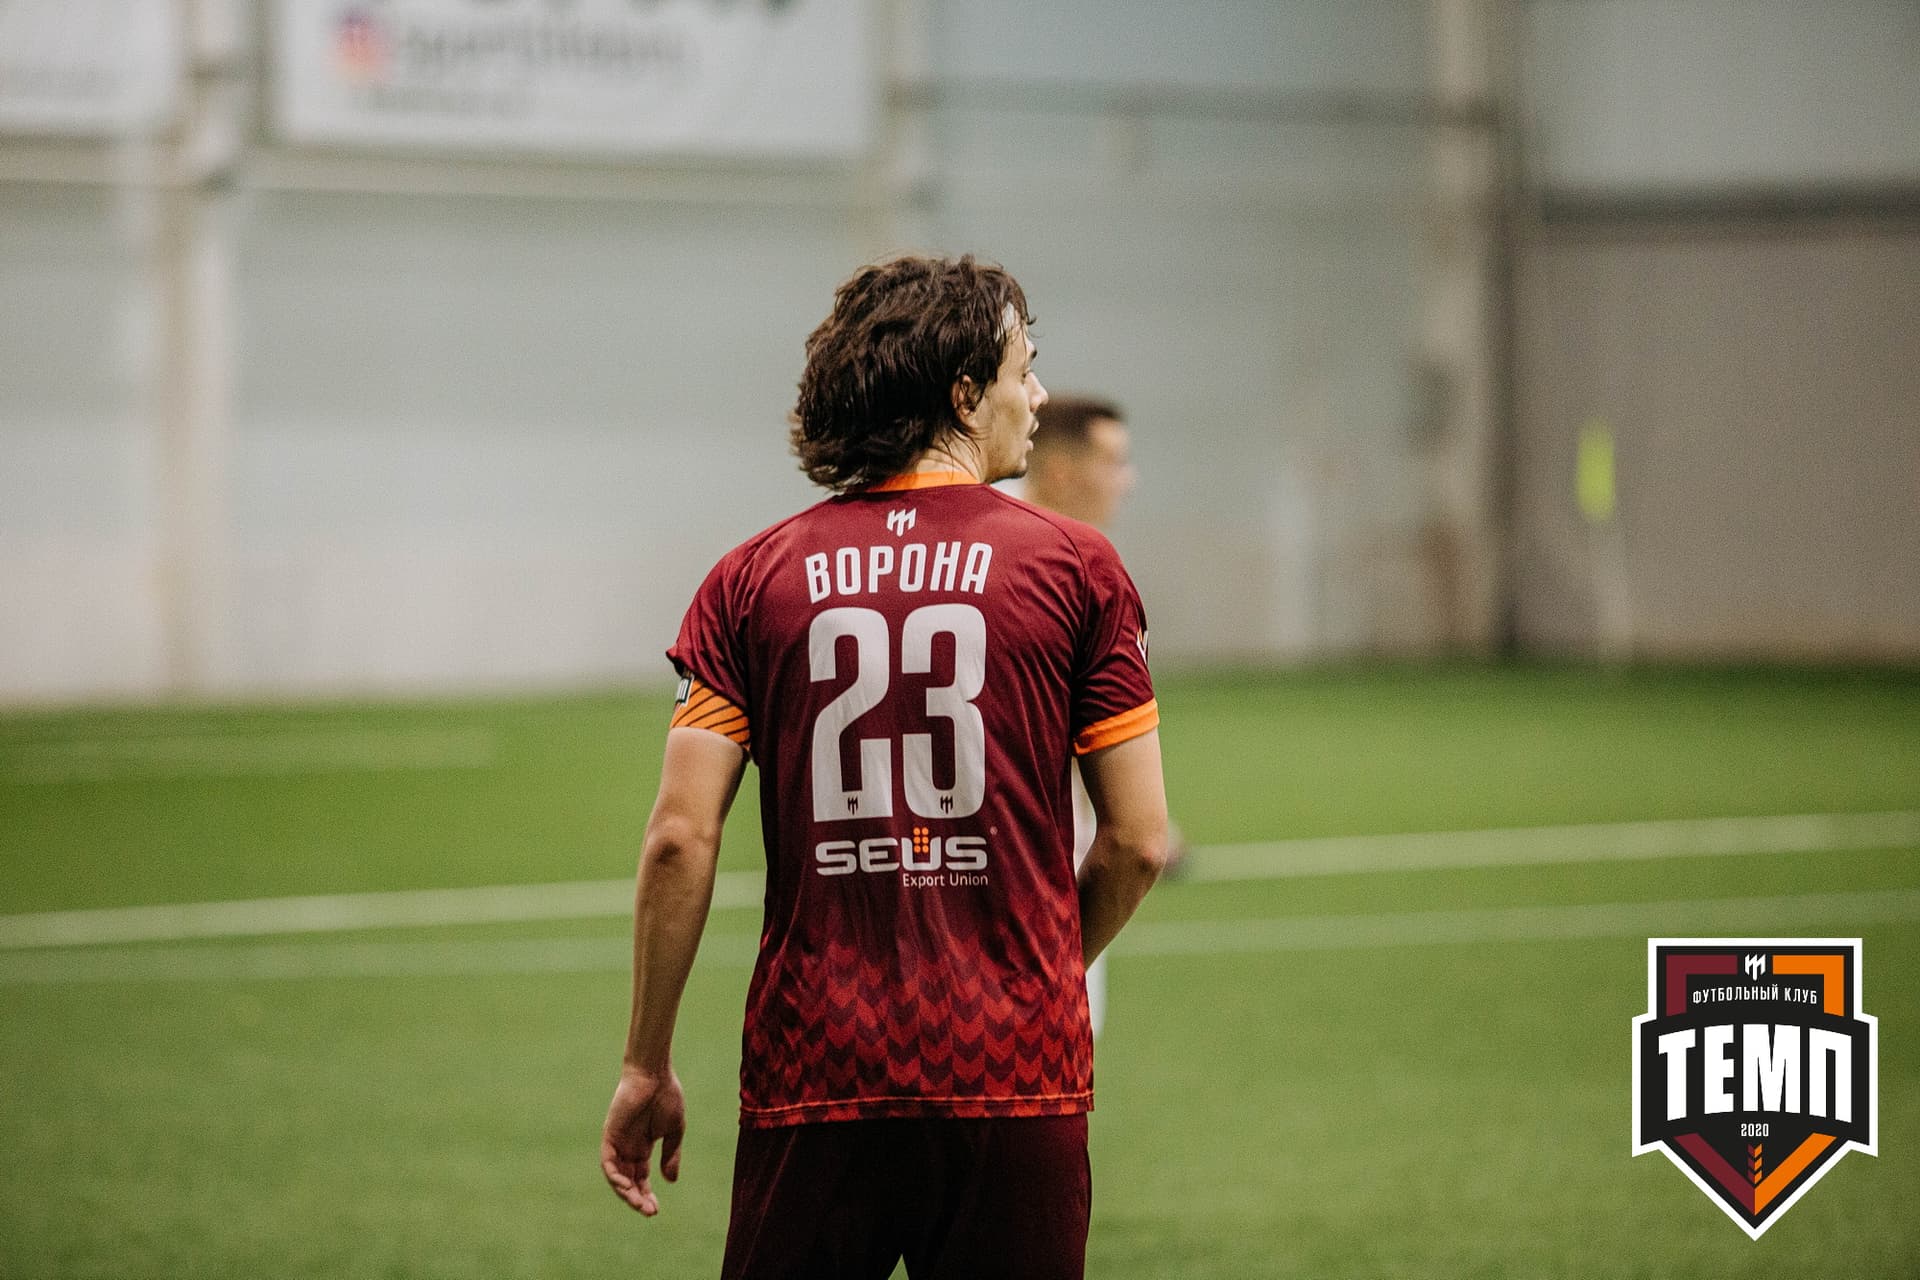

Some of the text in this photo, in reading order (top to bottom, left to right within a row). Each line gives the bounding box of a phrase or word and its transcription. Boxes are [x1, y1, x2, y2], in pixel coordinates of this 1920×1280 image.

[805, 541, 993, 604] ВОРОНА
[810, 604, 986, 822] 23
[903, 873, 989, 888] Export Union
